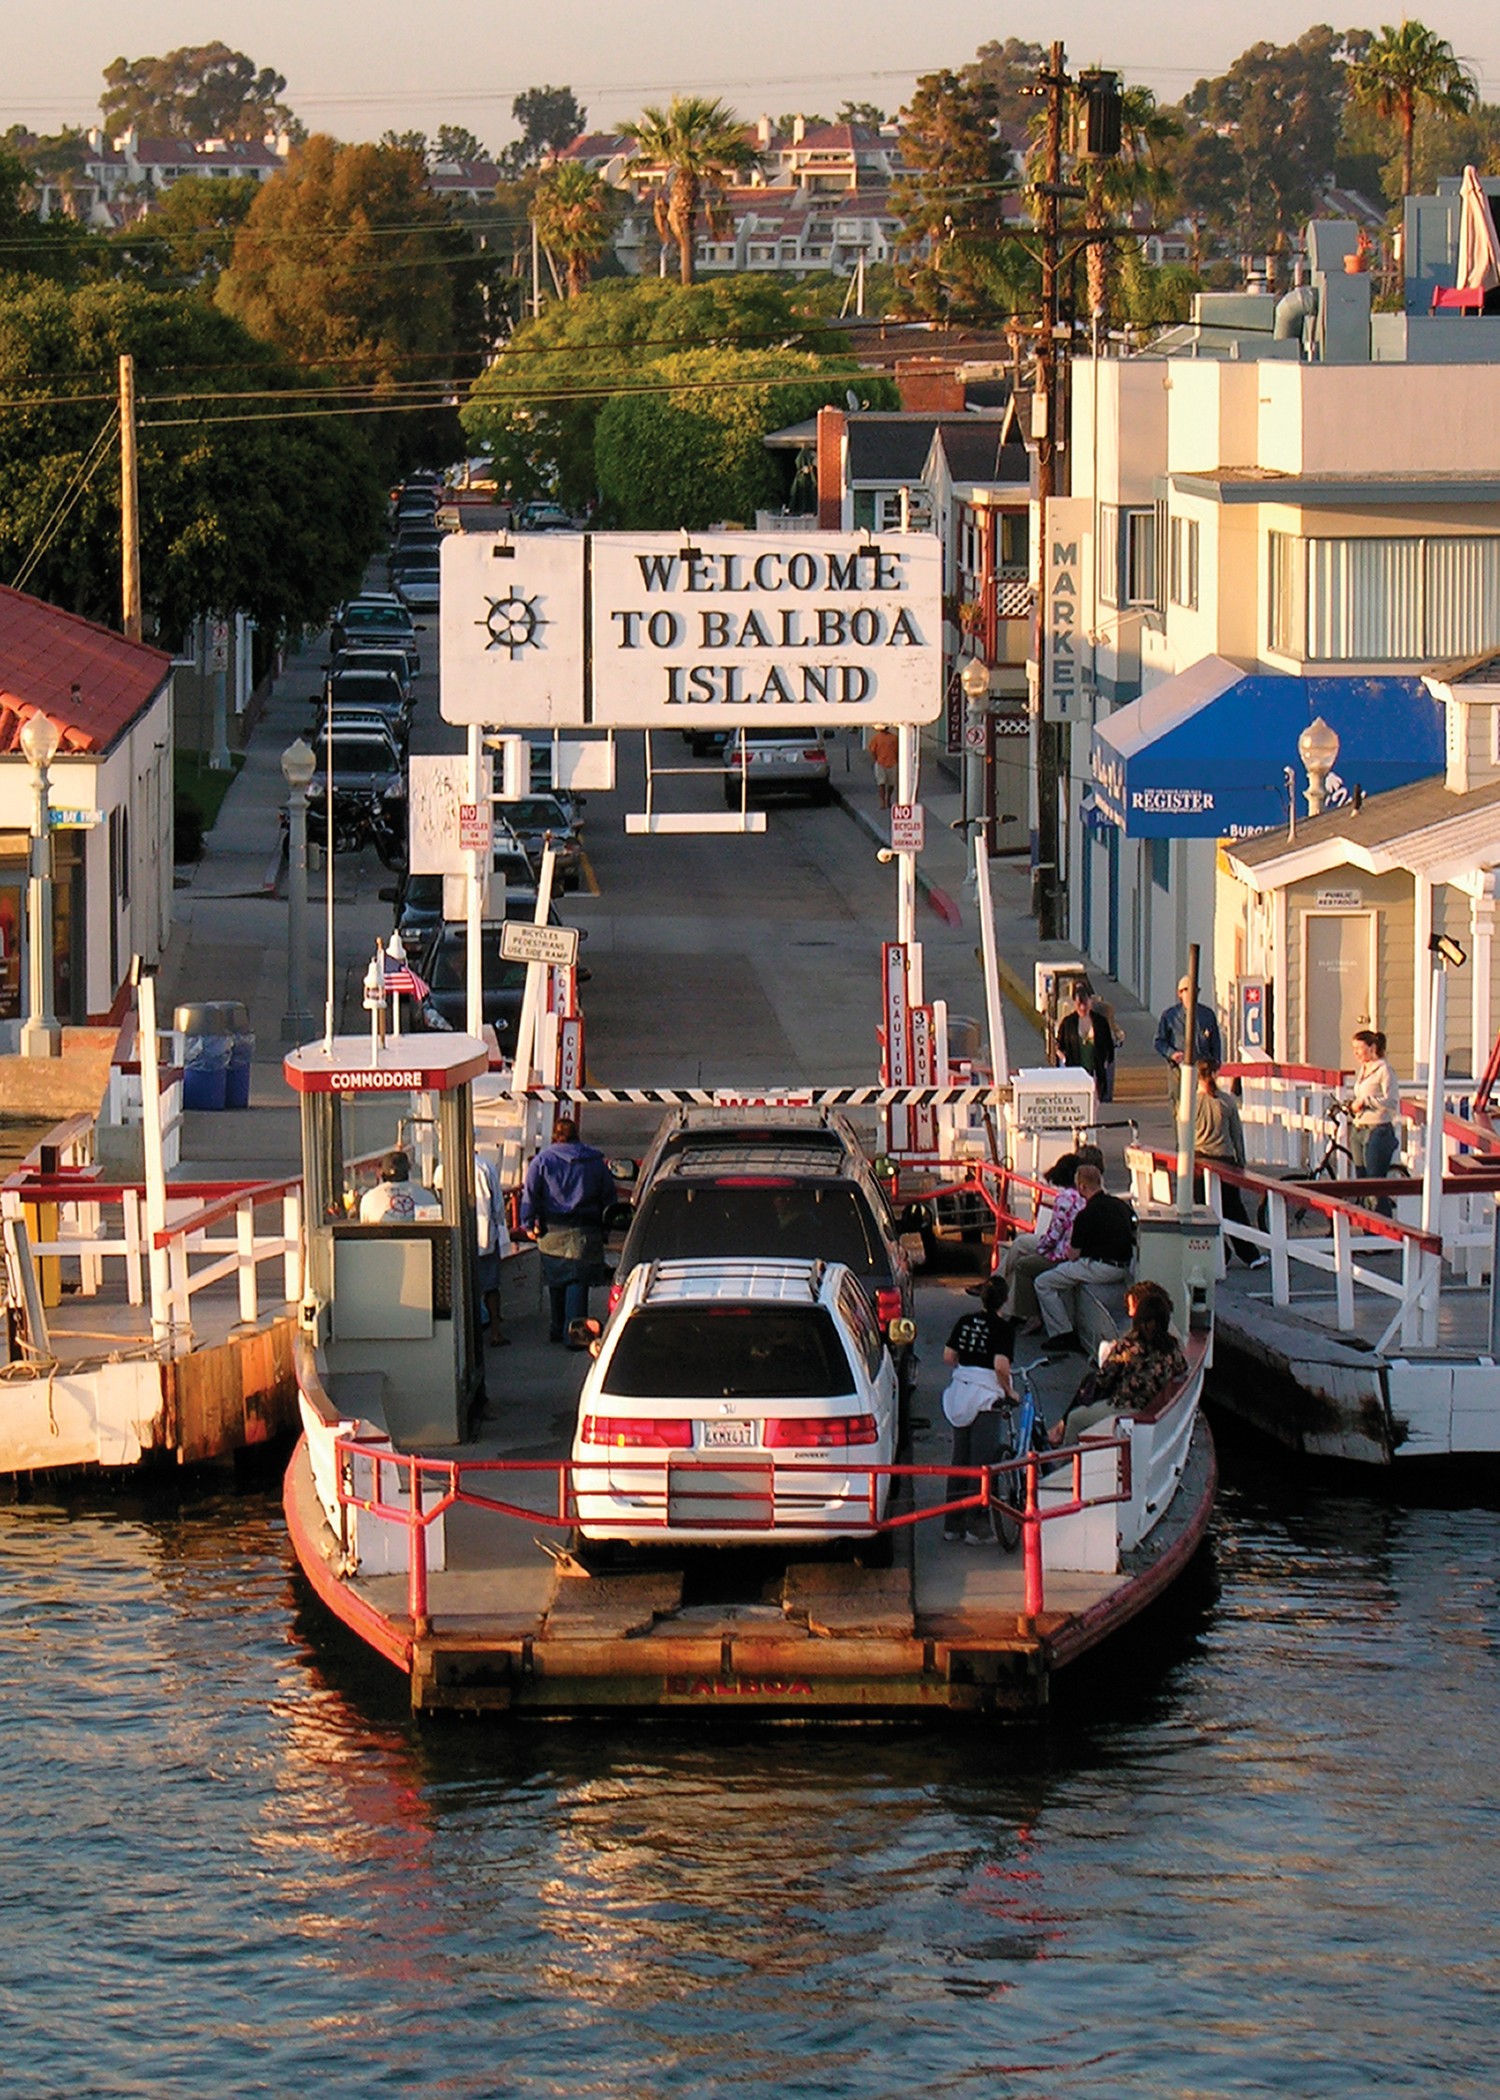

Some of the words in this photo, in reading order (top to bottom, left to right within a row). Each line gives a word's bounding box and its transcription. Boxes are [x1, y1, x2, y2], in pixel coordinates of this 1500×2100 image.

[634, 553, 902, 592] WELCOME
[611, 609, 677, 649] TO
[698, 607, 923, 648] BALBOA
[1052, 543, 1077, 713] MARKET
[664, 665, 870, 704] ISLAND
[1132, 792, 1214, 808] REGISTER
[461, 806, 476, 819] NO
[894, 806, 910, 819] NO
[1230, 824, 1275, 837] BURG
[522, 929, 559, 940] BICYCLES
[513, 937, 565, 950] PEDESTRIANS
[507, 945, 521, 954] USE
[525, 948, 542, 957] SIDE
[546, 951, 568, 959] RAMP
[892, 949, 901, 961] 3
[915, 1011, 924, 1024] 3
[893, 995, 902, 1086] CAUTION
[331, 1072, 422, 1088] COMMODORE
[917, 1034, 928, 1123] CAUTON
[1028, 1106, 1080, 1114] PEDESTRIANS
[664, 1676, 812, 1696] BALBOA
